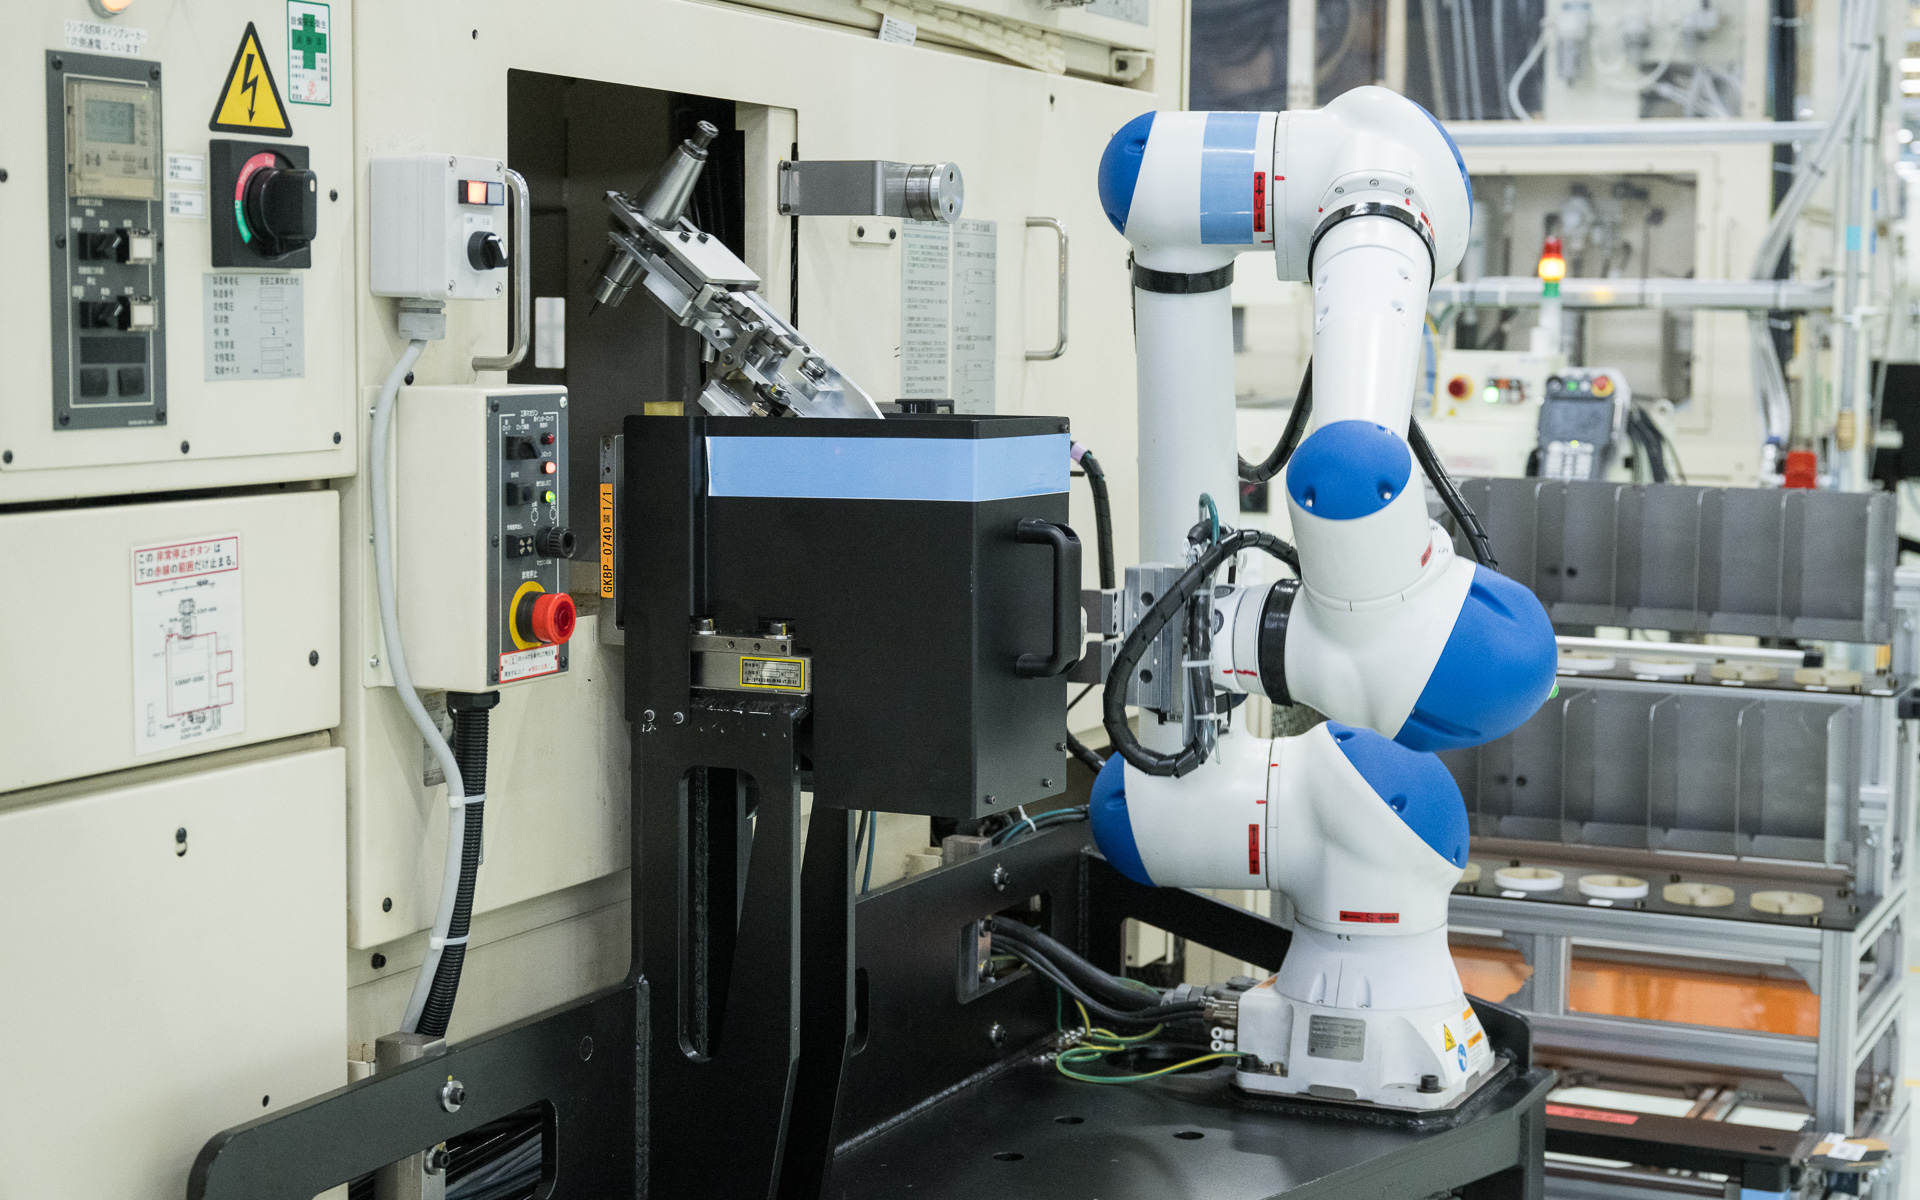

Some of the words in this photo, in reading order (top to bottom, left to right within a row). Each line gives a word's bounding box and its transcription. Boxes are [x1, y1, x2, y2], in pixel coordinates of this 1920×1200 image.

[1255, 199, 1263, 209] U
[271, 326, 276, 336] 3
[602, 492, 613, 510] 1/1
[138, 554, 153, 564] この
[157, 545, 210, 561] 非常停止ボタン
[214, 543, 220, 552] は
[603, 527, 613, 593] GKBP-0740
